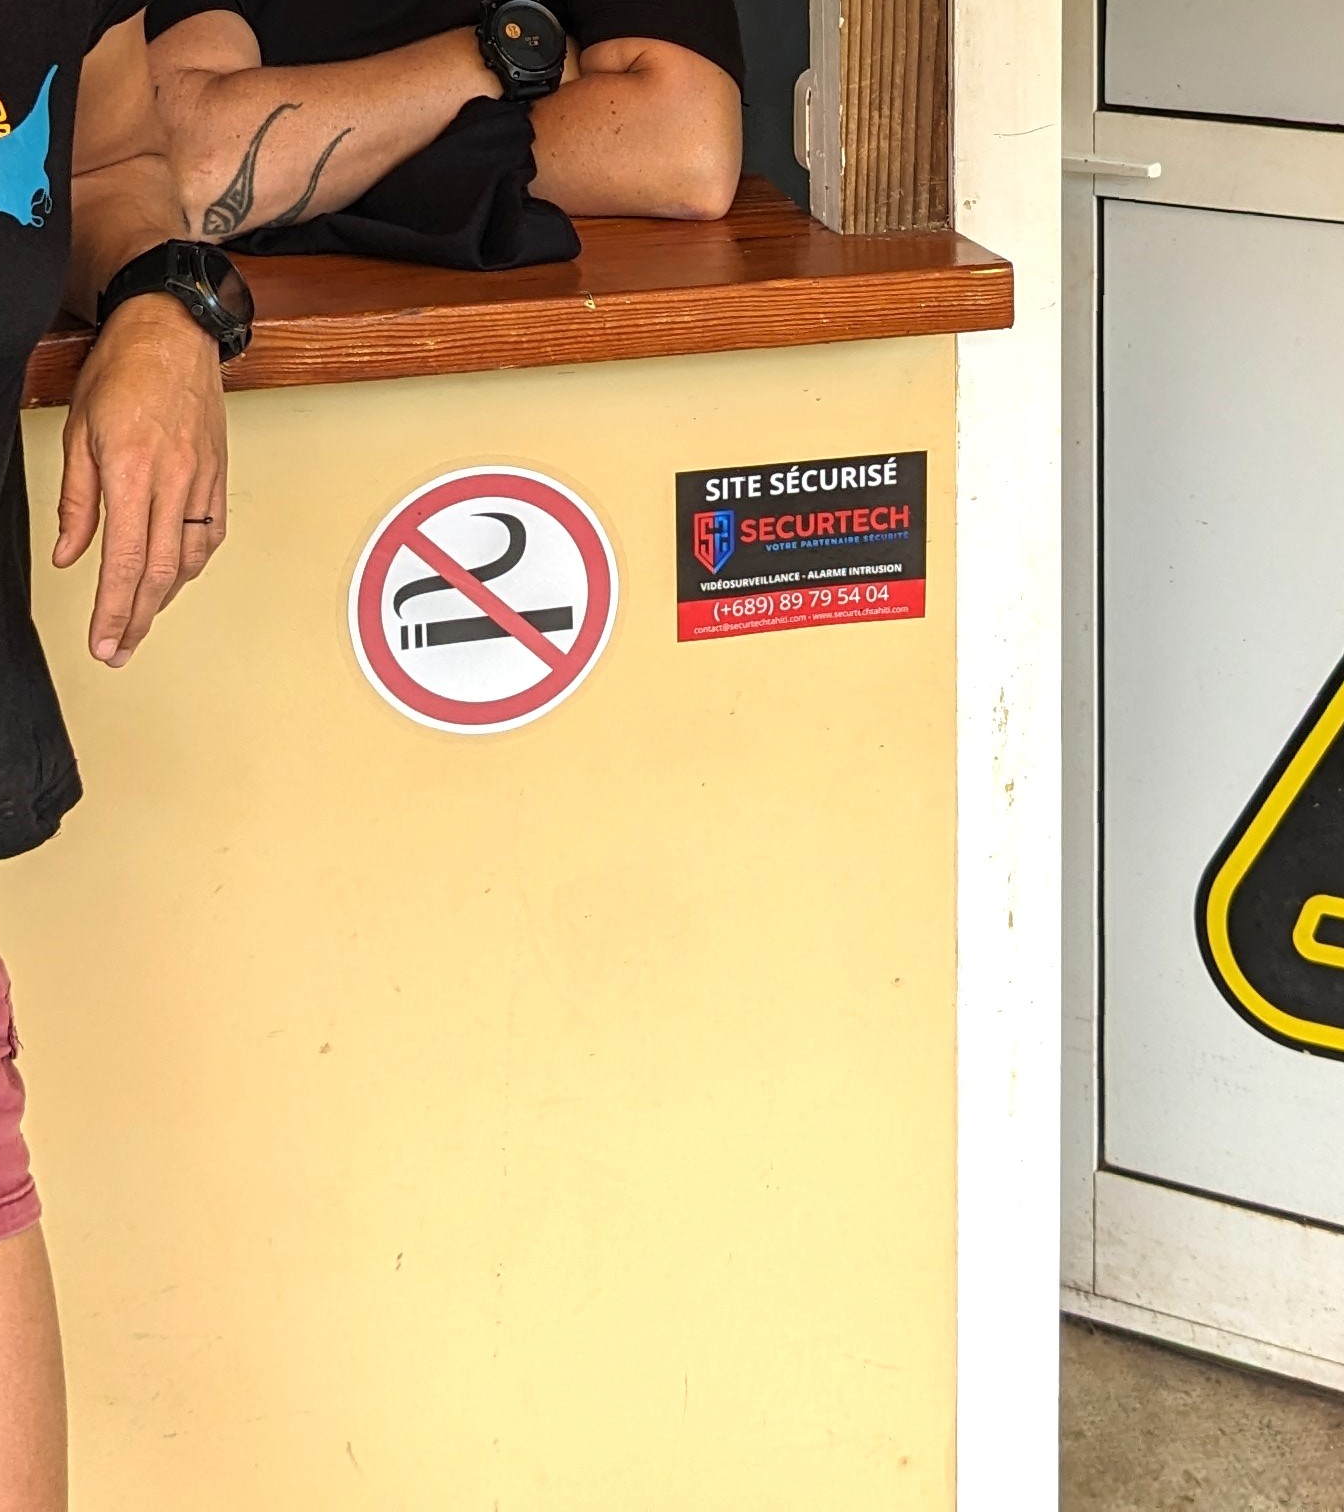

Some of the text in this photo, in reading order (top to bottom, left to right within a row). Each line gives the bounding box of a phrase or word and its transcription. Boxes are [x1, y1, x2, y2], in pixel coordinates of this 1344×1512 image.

[705, 456, 898, 502] SITE SÉCURISÉ
[740, 504, 910, 544] SECURTECH
[765, 541, 798, 552] VOTRE
[800, 535, 860, 548] PARTENAIRE
[700, 571, 800, 592] VIDÉOSURVEILLANCE
[807, 567, 847, 580] ALARME
[848, 563, 903, 576] INTRUSION
[713, 584, 890, 622] (+689) 89 79 54 04
